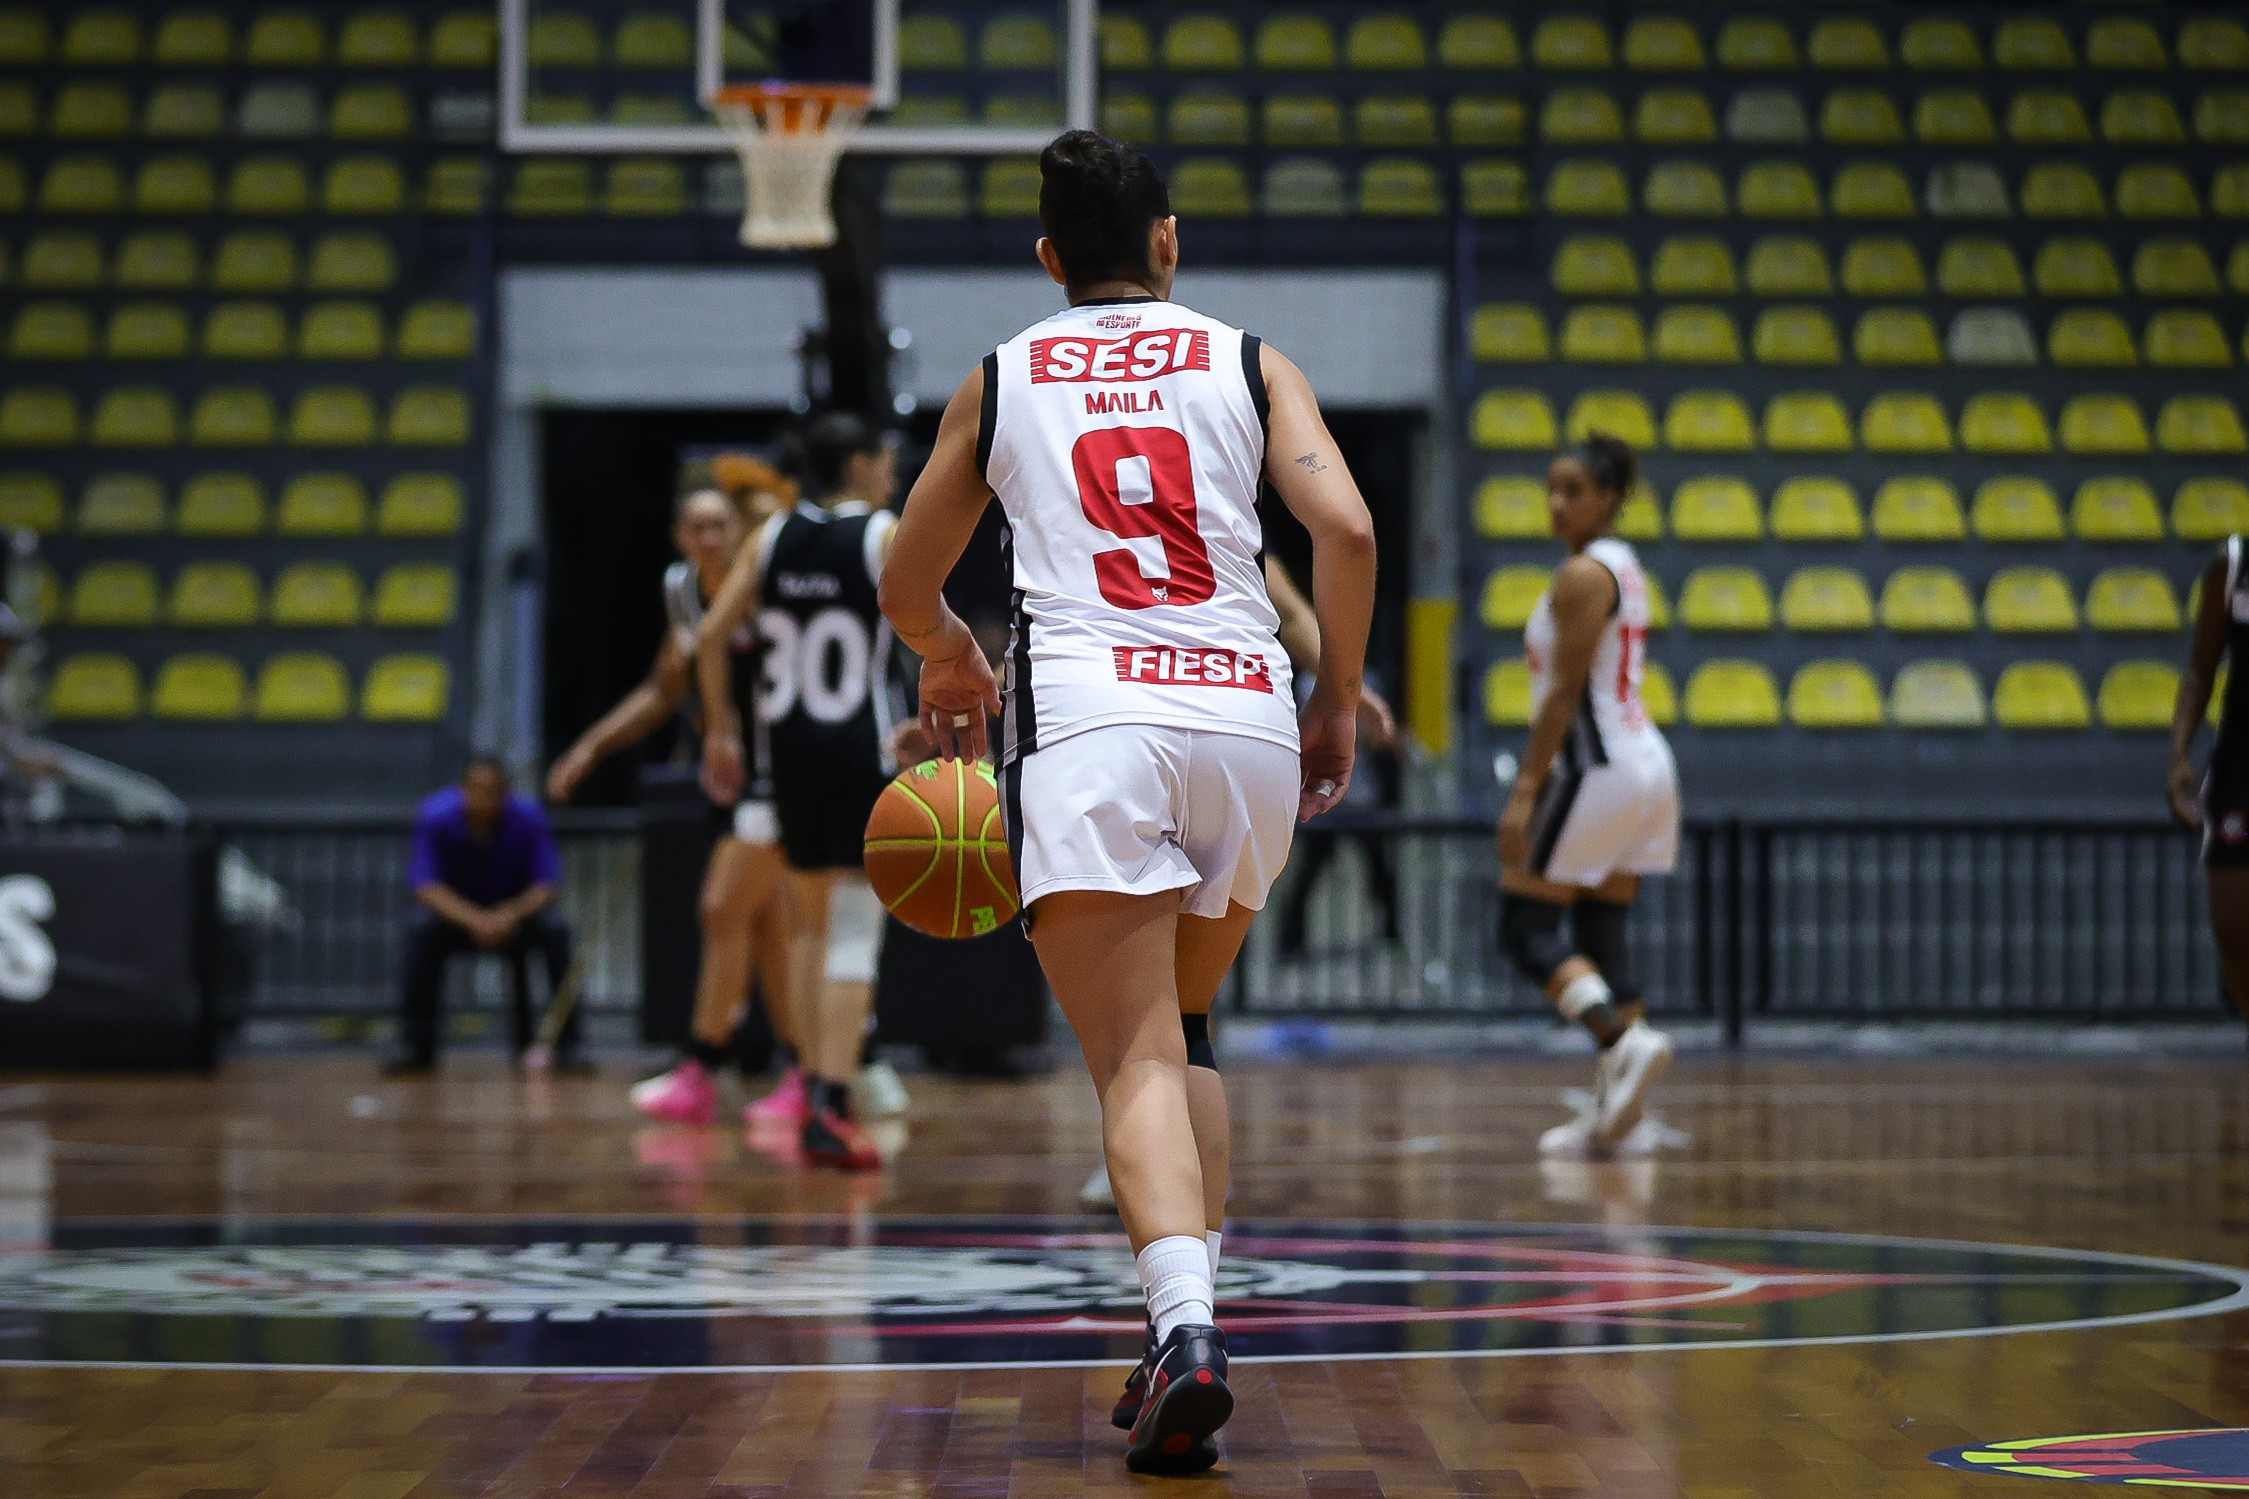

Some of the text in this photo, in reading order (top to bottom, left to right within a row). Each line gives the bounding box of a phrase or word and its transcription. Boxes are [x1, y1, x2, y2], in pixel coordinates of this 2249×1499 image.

[1045, 331, 1194, 379] SESI
[1085, 389, 1164, 414] MAILA
[1072, 426, 1217, 610] 9
[752, 605, 870, 725] 30
[1129, 650, 1261, 684] FIESP
